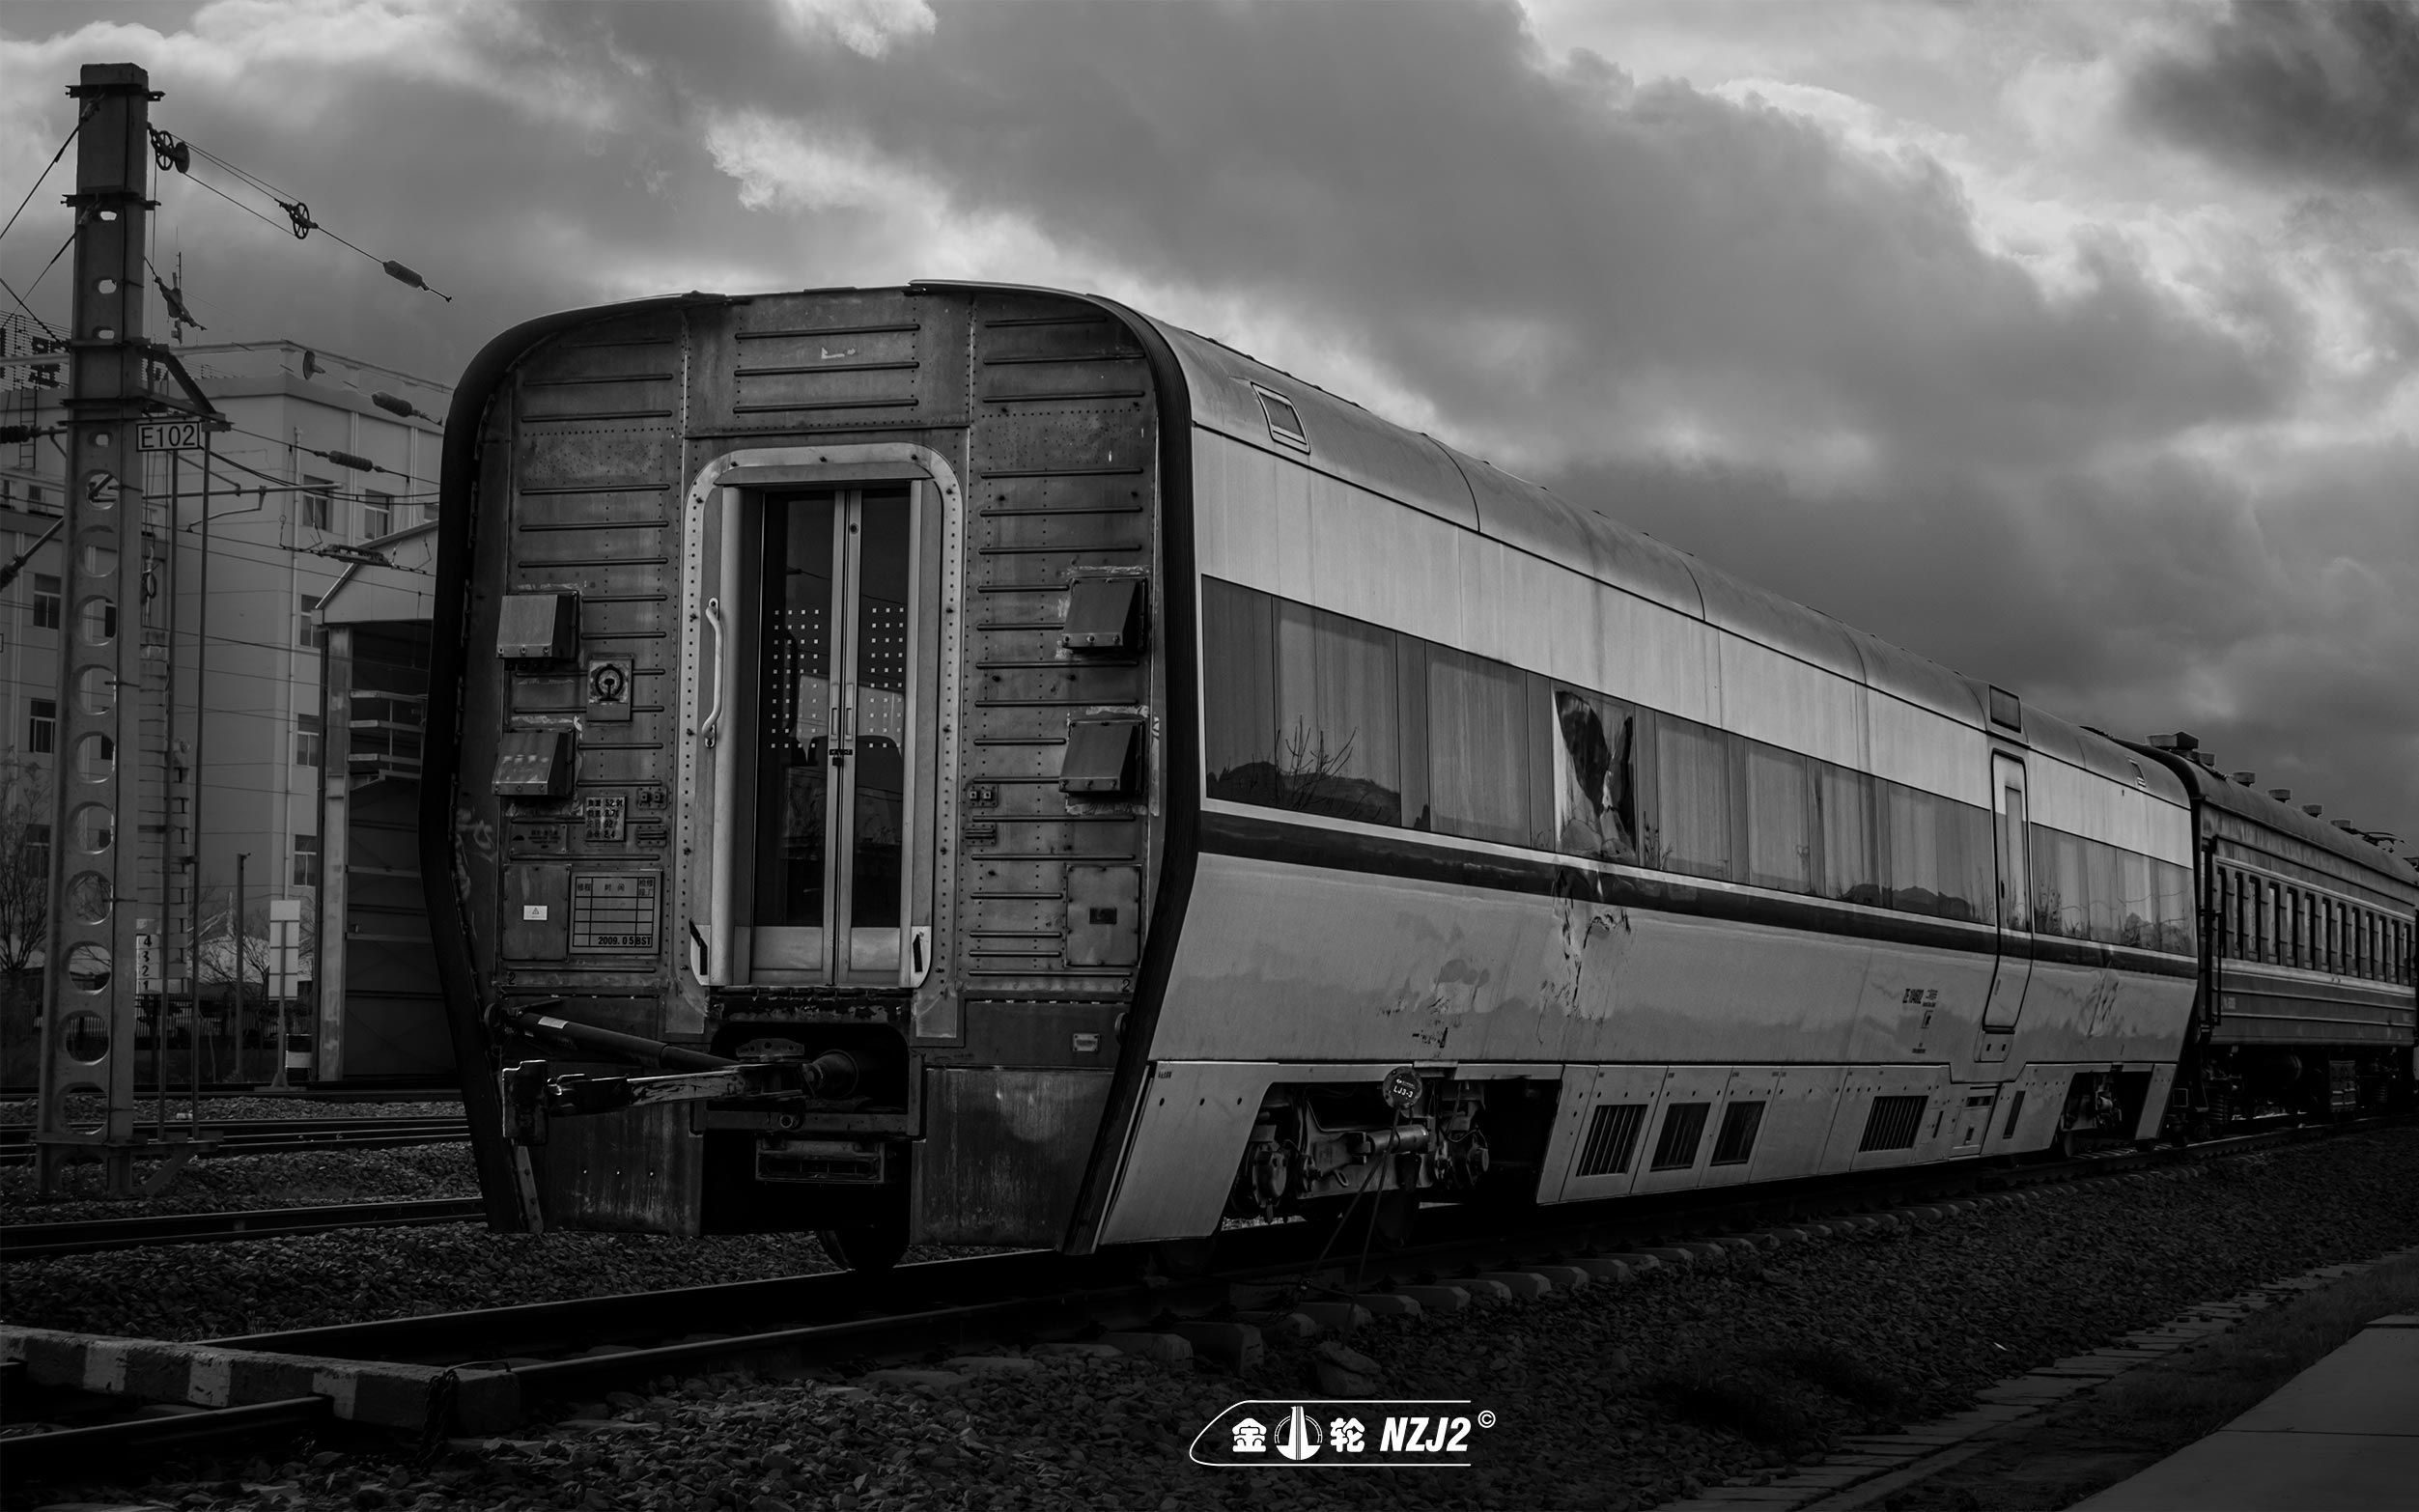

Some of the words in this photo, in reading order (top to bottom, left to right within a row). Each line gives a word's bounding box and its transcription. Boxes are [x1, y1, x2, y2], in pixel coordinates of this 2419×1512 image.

[141, 425, 195, 448] E102
[144, 935, 153, 947] 4
[142, 950, 150, 963] 3
[142, 965, 150, 977] 2
[508, 971, 516, 985] 2
[143, 980, 149, 990] 1
[1122, 978, 1131, 993] 2
[1392, 1085, 1414, 1098] LJ3-3
